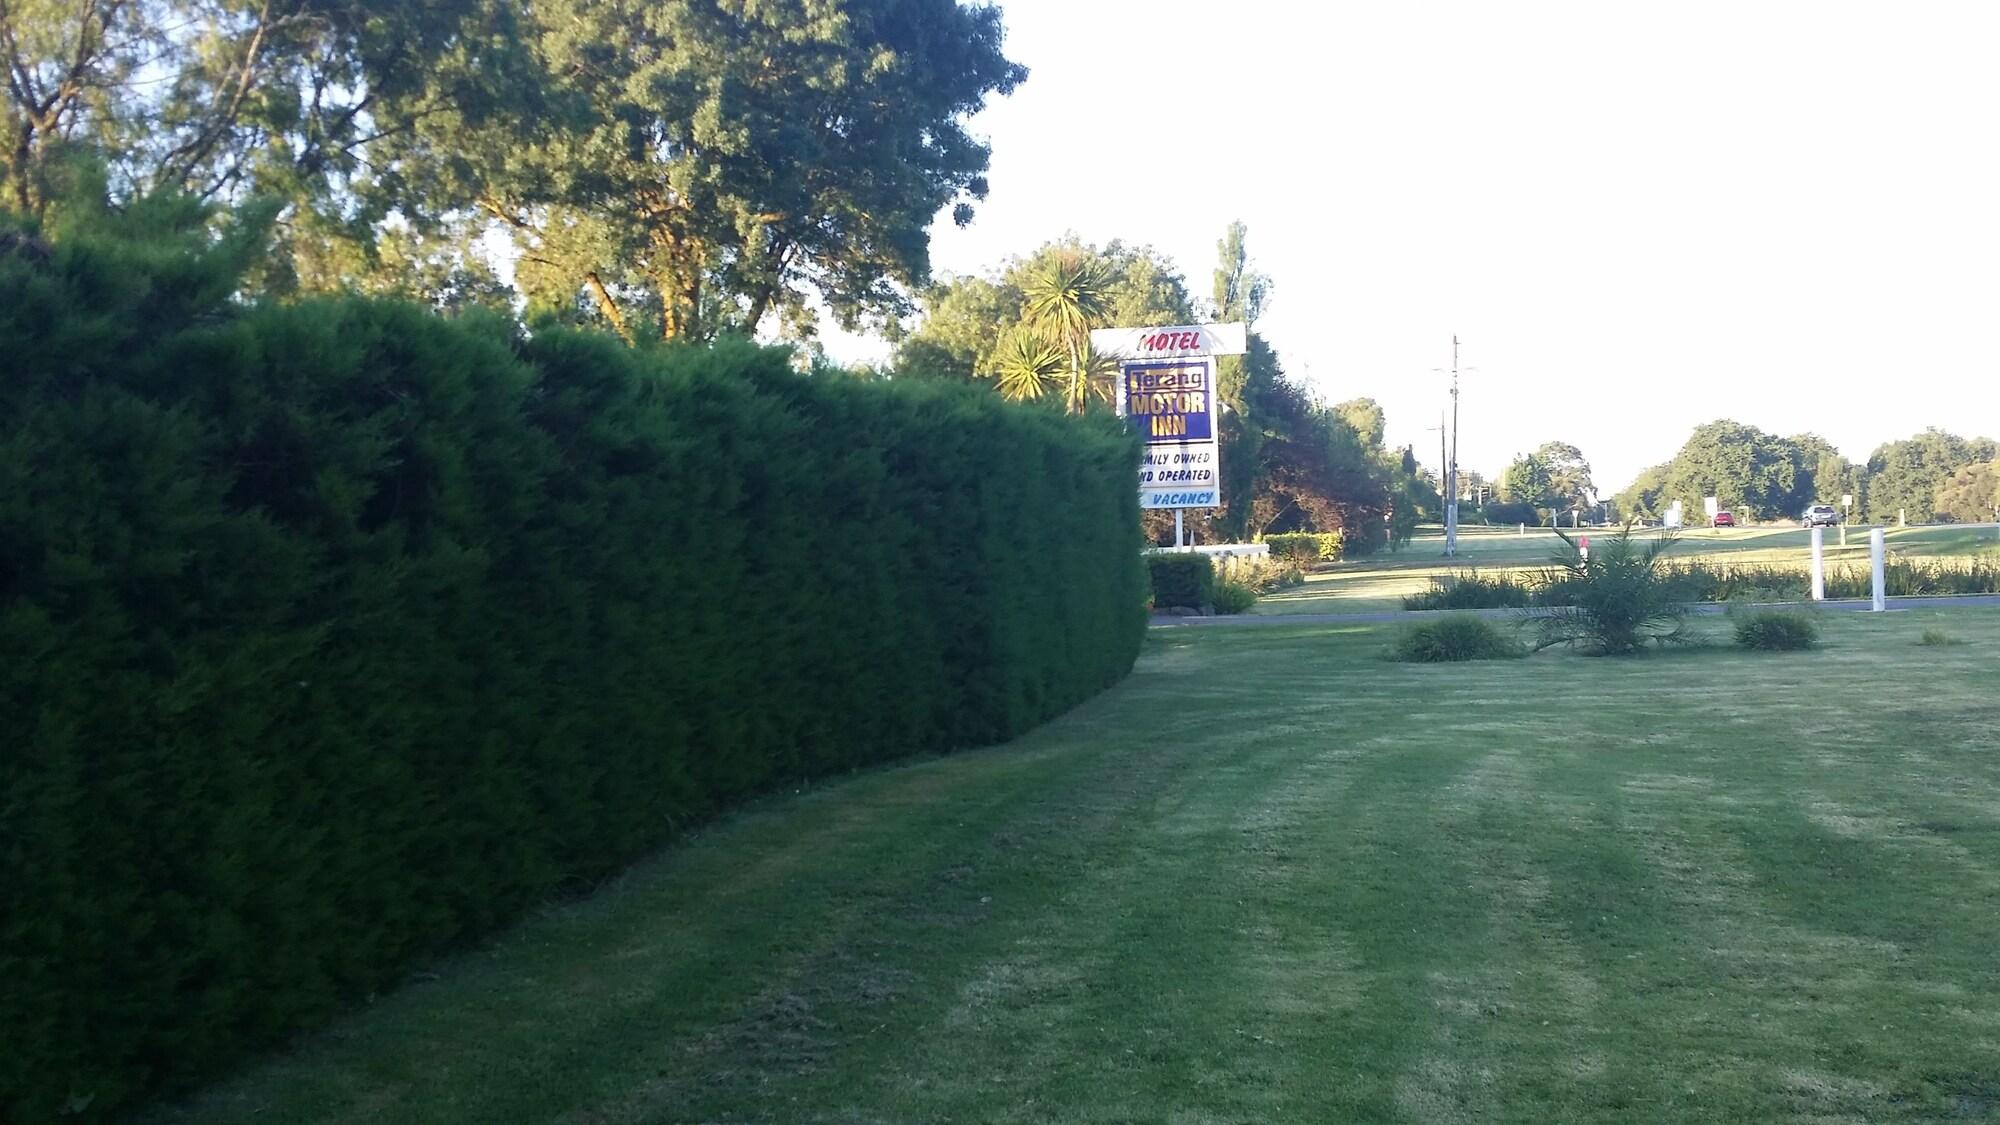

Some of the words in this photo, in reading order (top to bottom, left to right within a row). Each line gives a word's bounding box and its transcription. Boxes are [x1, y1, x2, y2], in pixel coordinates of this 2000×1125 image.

[1137, 332, 1200, 351] MOTEL
[1132, 371, 1202, 388] Terang
[1132, 392, 1205, 415] MOTOR
[1152, 415, 1185, 436] INN
[1144, 454, 1169, 465] MILY
[1174, 453, 1210, 464] OWNED
[1141, 471, 1153, 482] ND
[1159, 470, 1211, 481] OPERATED
[1153, 492, 1214, 504] VACANCY
